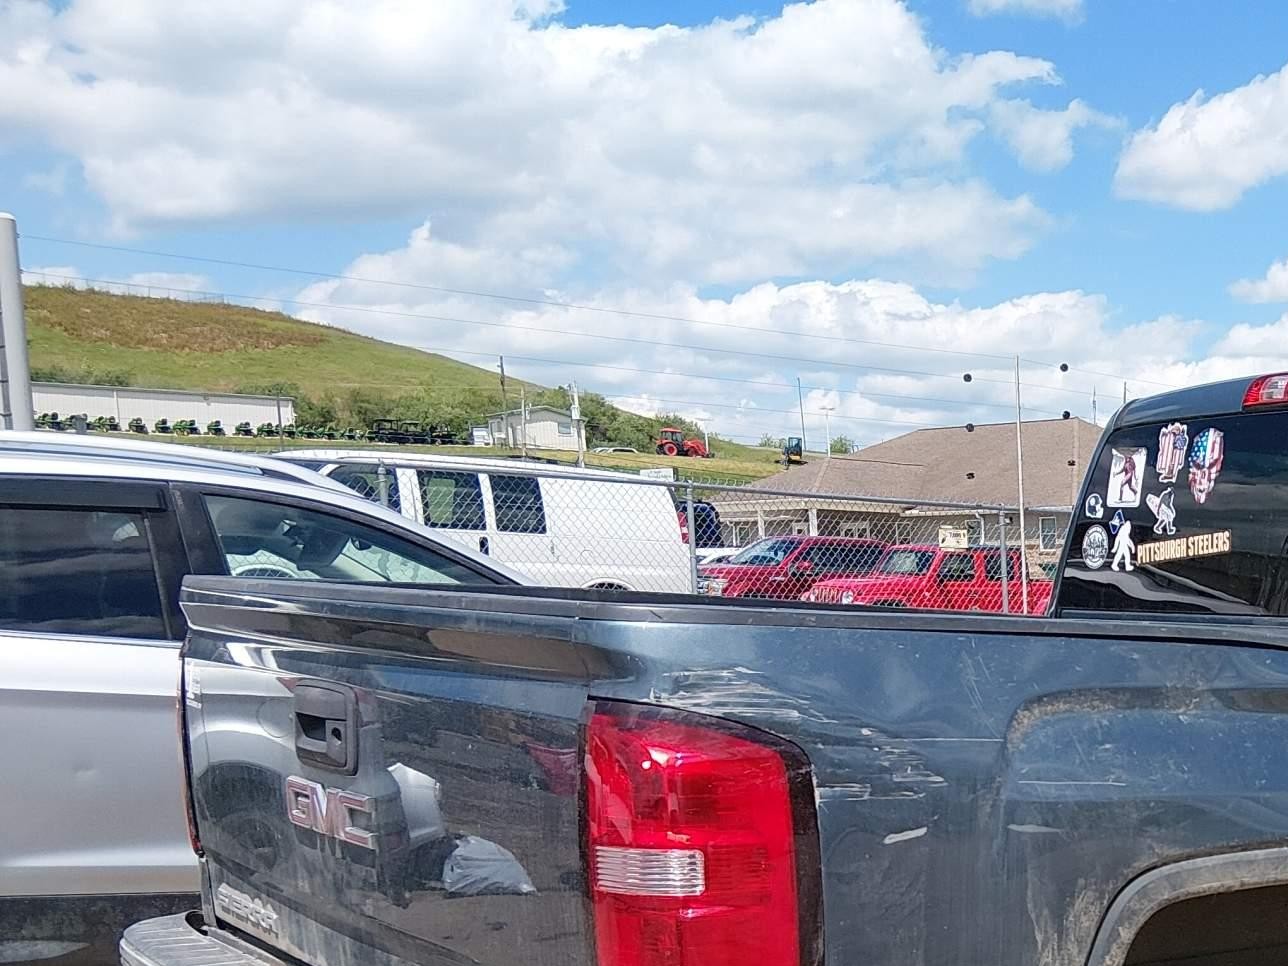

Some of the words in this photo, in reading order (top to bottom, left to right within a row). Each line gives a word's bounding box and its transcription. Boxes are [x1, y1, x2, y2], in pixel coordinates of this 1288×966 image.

[1137, 537, 1187, 564] PITTSBURGH
[1188, 531, 1230, 557] STEELERS
[286, 775, 379, 850] GMC
[217, 883, 279, 930] SIERRA
